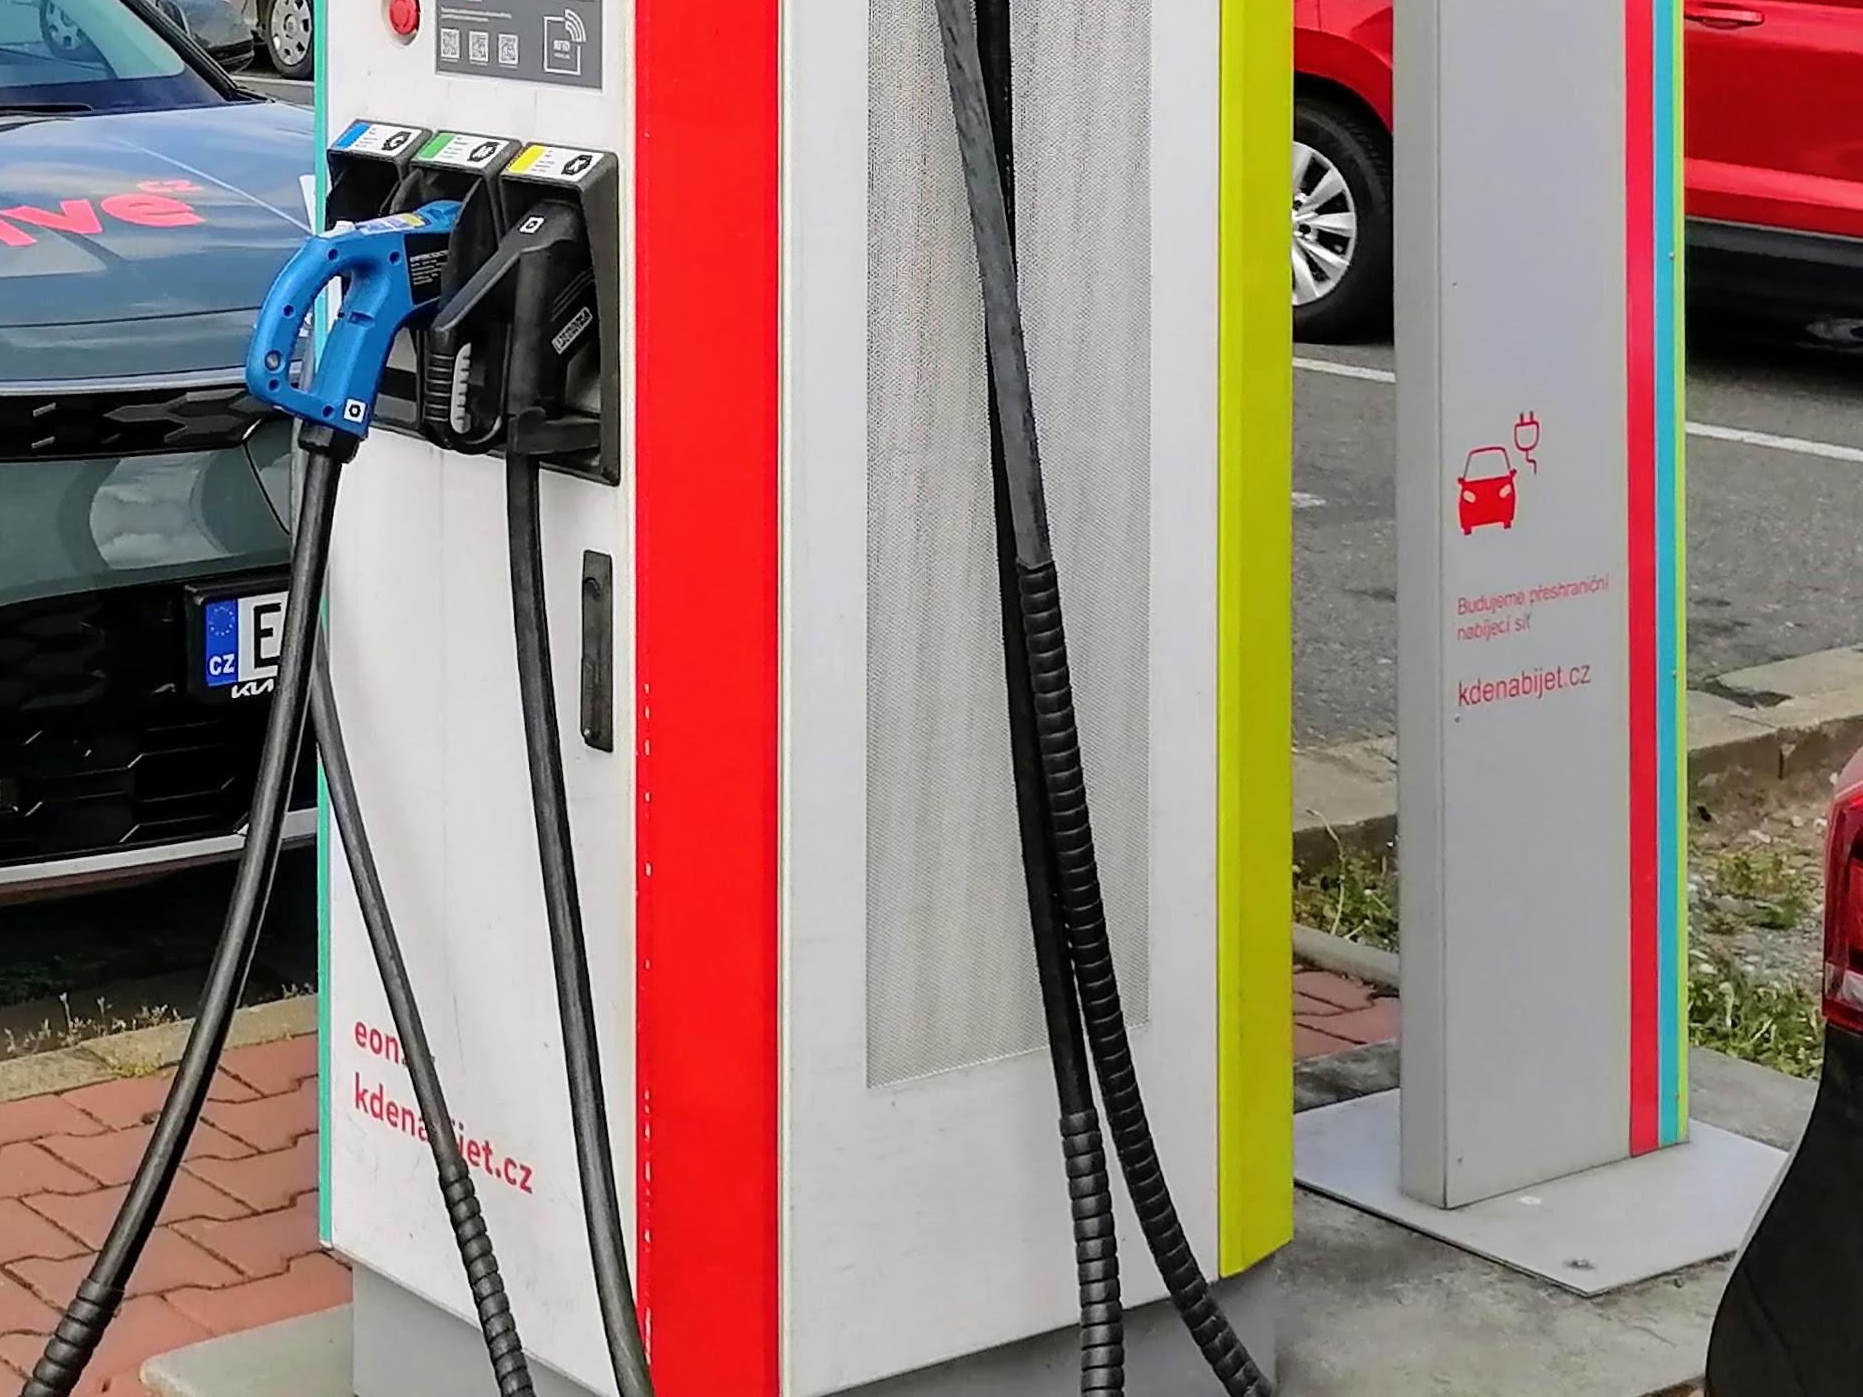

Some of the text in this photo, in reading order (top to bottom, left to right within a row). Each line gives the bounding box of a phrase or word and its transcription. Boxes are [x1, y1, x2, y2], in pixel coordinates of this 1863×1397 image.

[1457, 590, 1525, 615] Budujeme
[209, 653, 235, 675] CZ
[1458, 664, 1592, 707] kdenabijet.cz
[354, 1072, 533, 1194] kdenajet.cz
